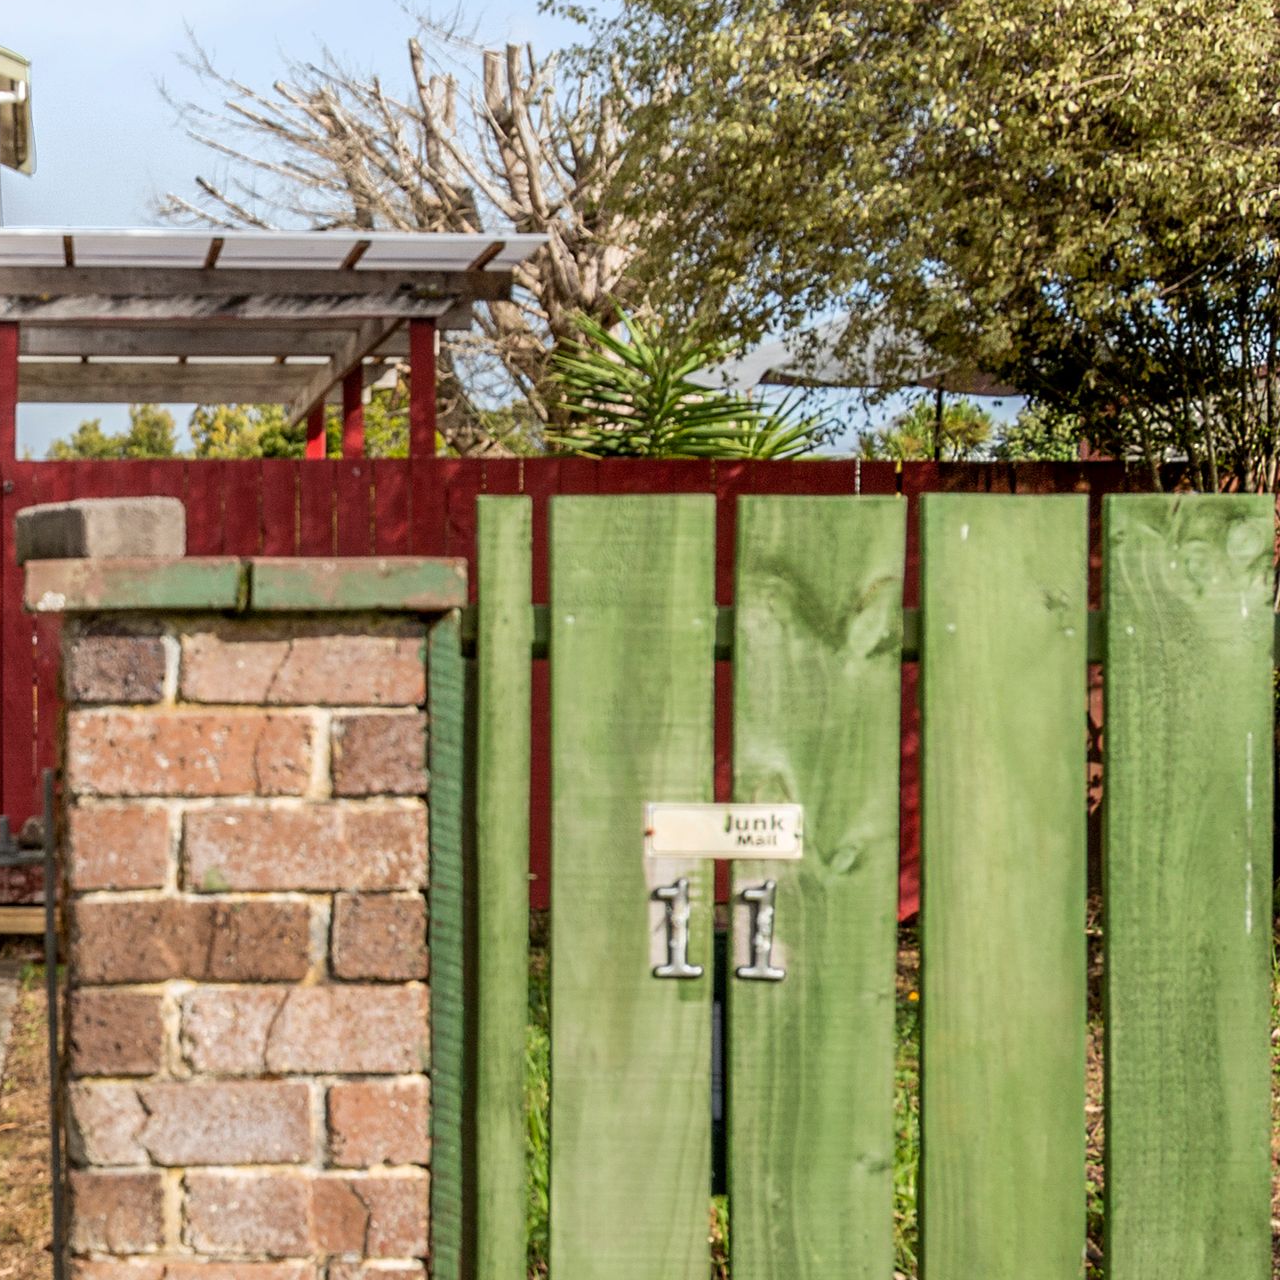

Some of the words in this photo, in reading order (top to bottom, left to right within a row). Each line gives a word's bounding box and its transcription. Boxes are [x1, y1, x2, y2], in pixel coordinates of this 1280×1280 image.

[724, 814, 783, 833] Junk
[738, 835, 777, 846] Mail
[652, 878, 784, 978] 11
